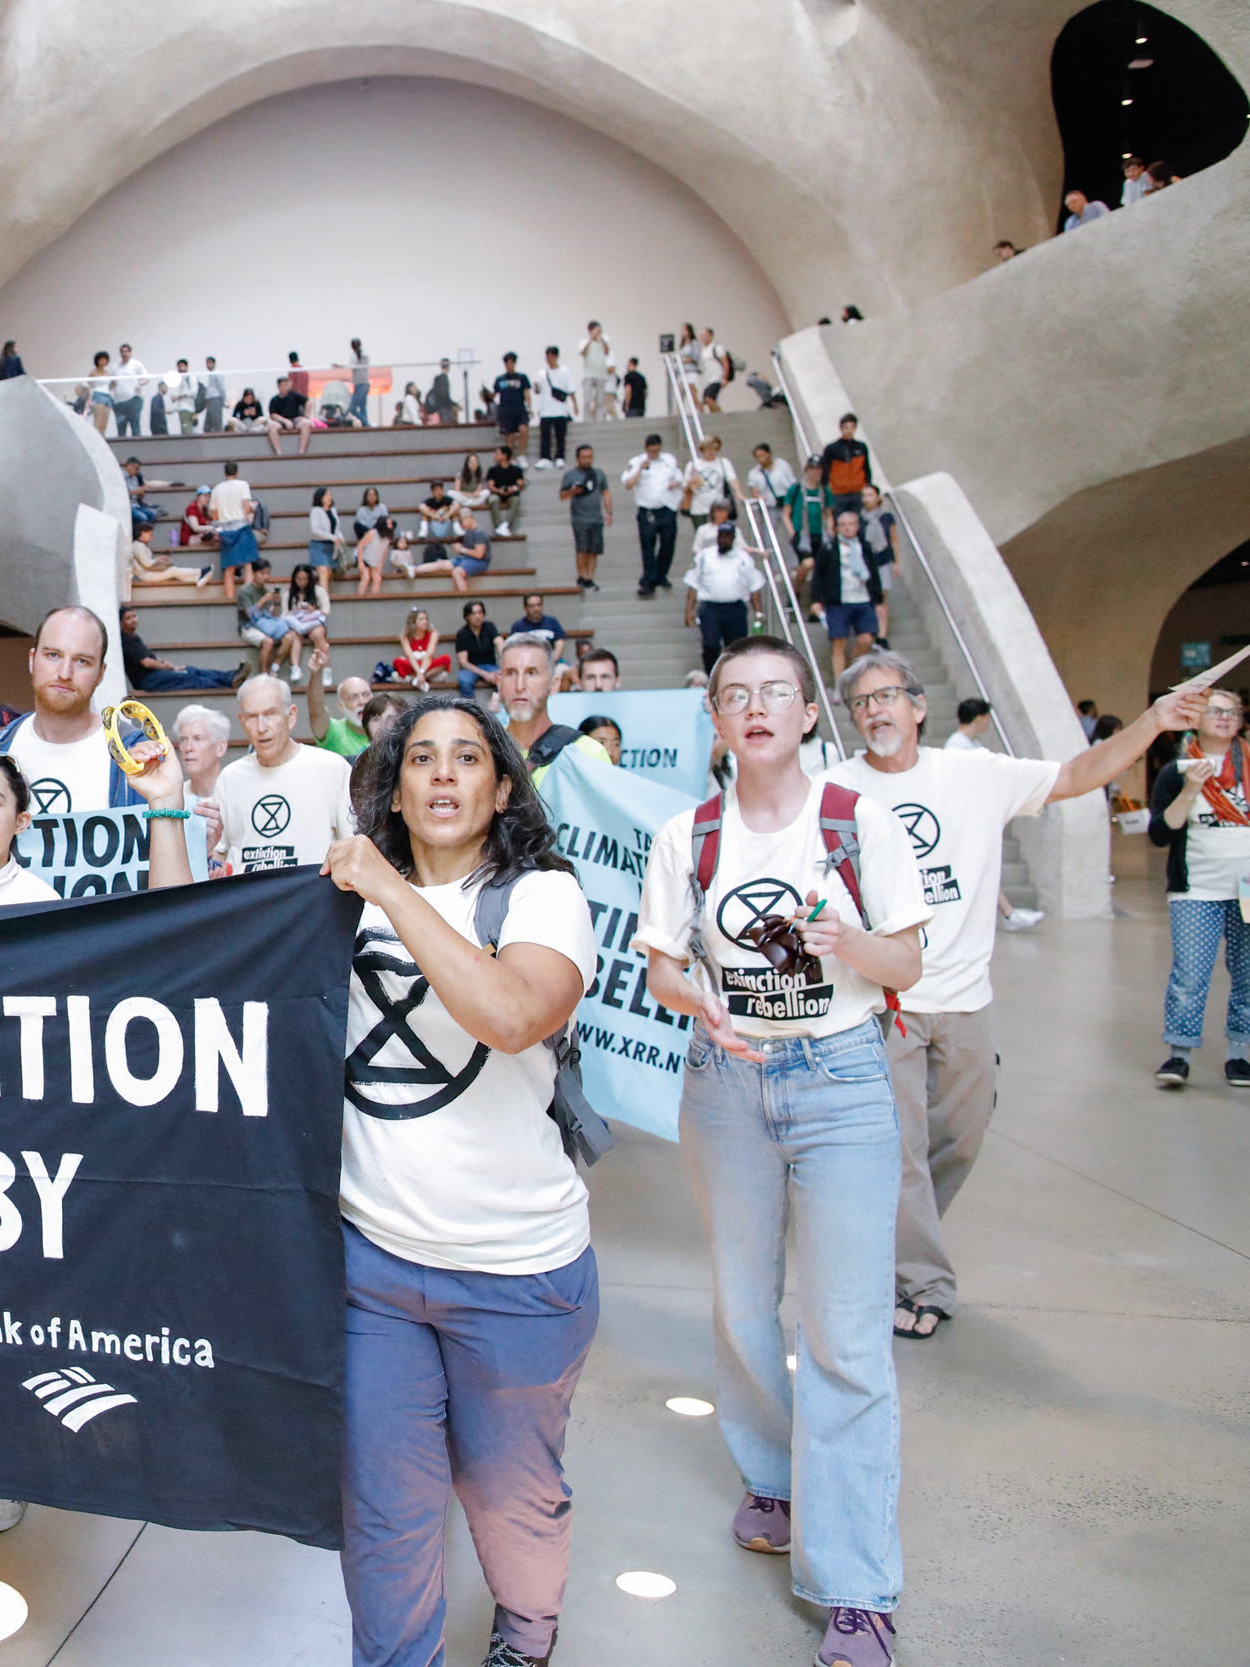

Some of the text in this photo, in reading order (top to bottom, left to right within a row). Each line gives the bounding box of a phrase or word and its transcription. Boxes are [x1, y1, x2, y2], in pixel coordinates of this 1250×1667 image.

[619, 749, 678, 768] CTION
[556, 823, 648, 879] CLIMAT
[924, 884, 959, 904] ellion
[746, 988, 830, 1018] rebellion
[31, 1317, 61, 1348] of
[69, 1320, 214, 1368] America
